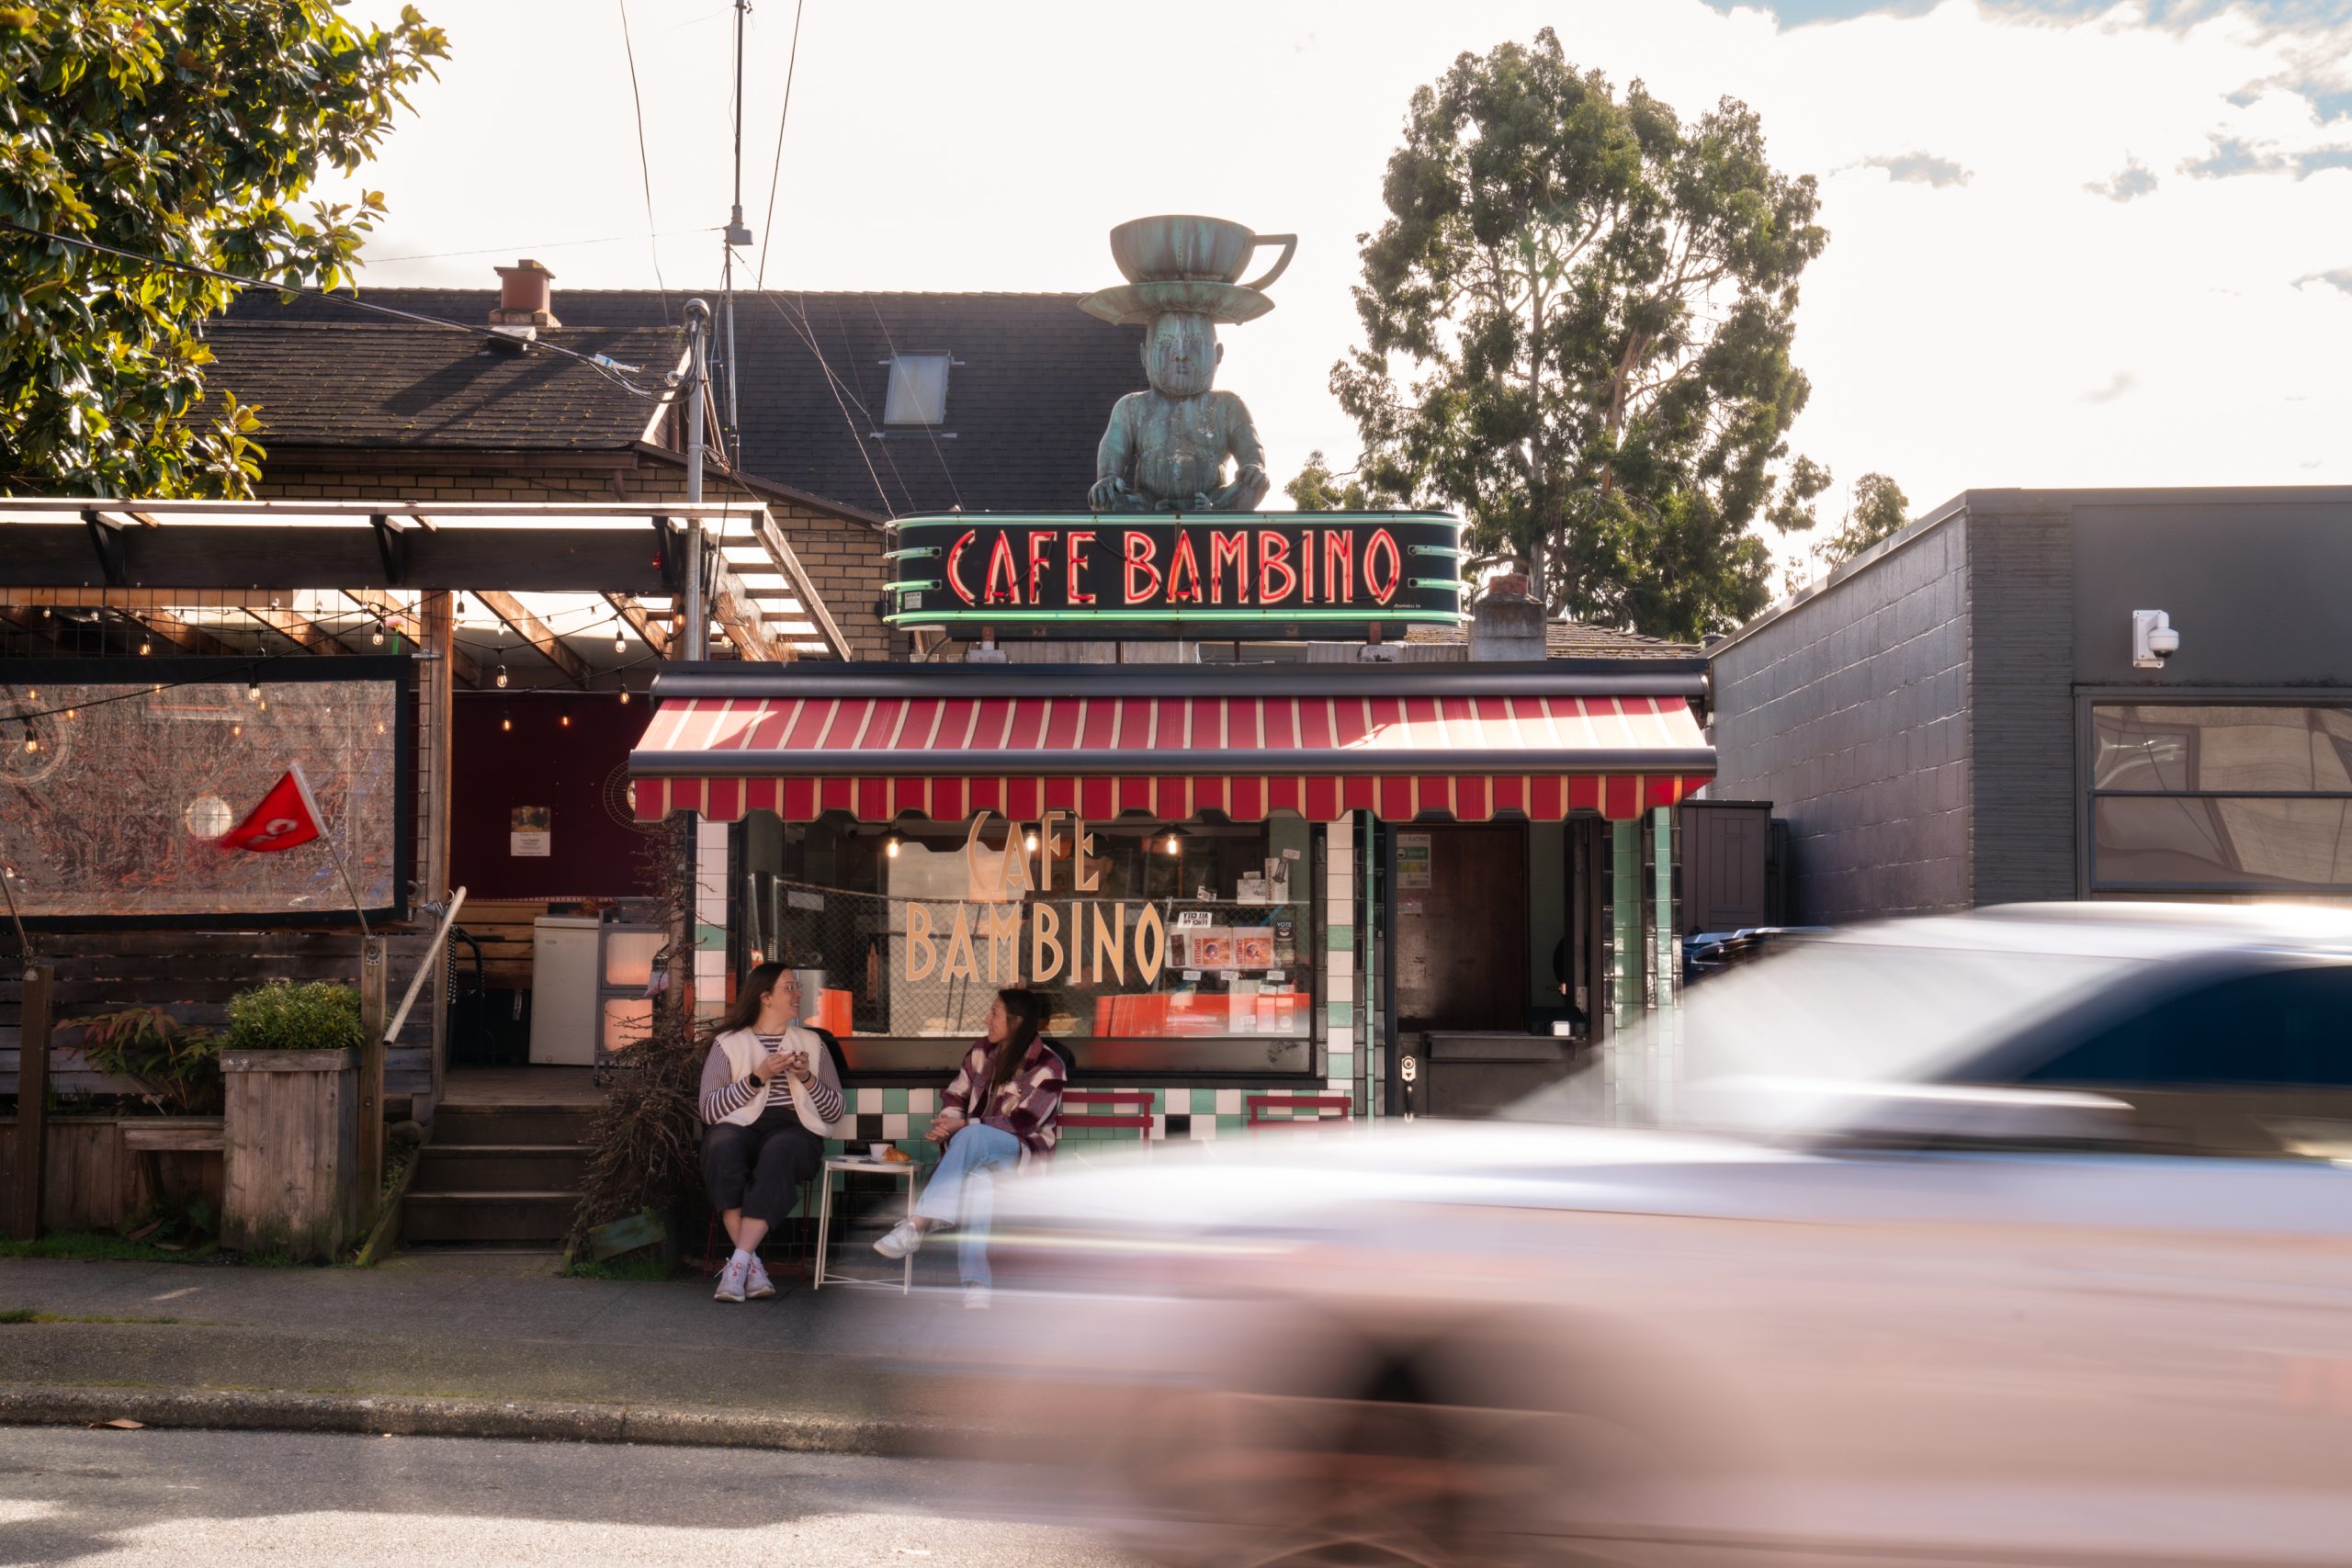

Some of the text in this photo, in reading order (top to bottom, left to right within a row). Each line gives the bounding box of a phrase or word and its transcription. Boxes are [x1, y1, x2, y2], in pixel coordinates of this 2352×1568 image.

[947, 527, 1401, 607] CAFE BAMBINO
[967, 811, 1099, 891] CAFE
[906, 900, 1165, 987] BAMBINO
